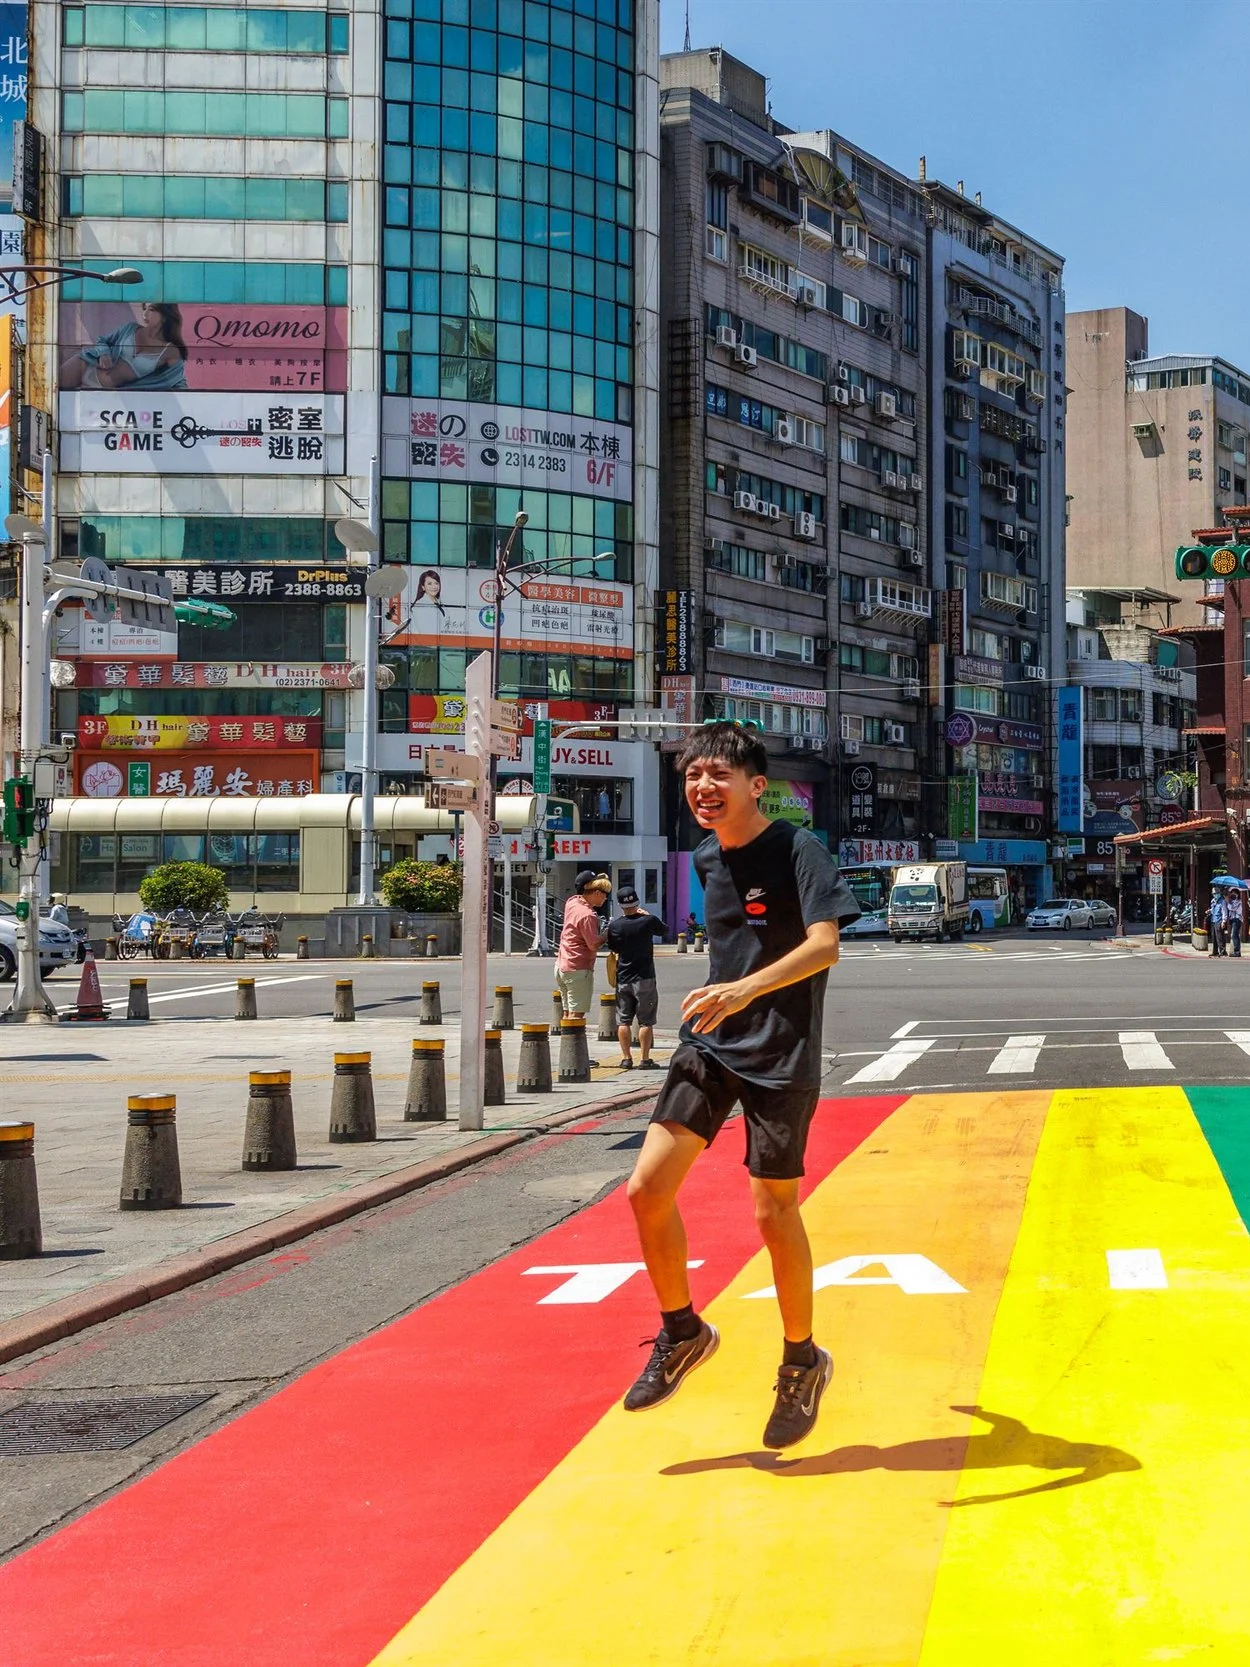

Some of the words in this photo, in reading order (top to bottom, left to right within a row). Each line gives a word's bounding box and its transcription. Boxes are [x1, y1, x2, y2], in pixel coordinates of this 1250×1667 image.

[193, 315, 320, 347] Qmomo
[268, 406, 323, 431] 密室
[104, 432, 163, 451] GAME
[505, 425, 576, 450] LOSTTW.COM
[580, 431, 621, 460] 本棟
[268, 436, 323, 460] 逃脫
[505, 452, 536, 469] 2314
[538, 456, 566, 472] 2383
[586, 458, 616, 487] 6/F
[297, 570, 349, 582] DrPlus
[284, 583, 362, 597] 2388-8863
[275, 678, 341, 687] (02)2371-0641
[286, 668, 319, 678] hair
[84, 719, 107, 735] 3F
[162, 723, 183, 731] hair
[1061, 702, 1077, 741] 青龍
